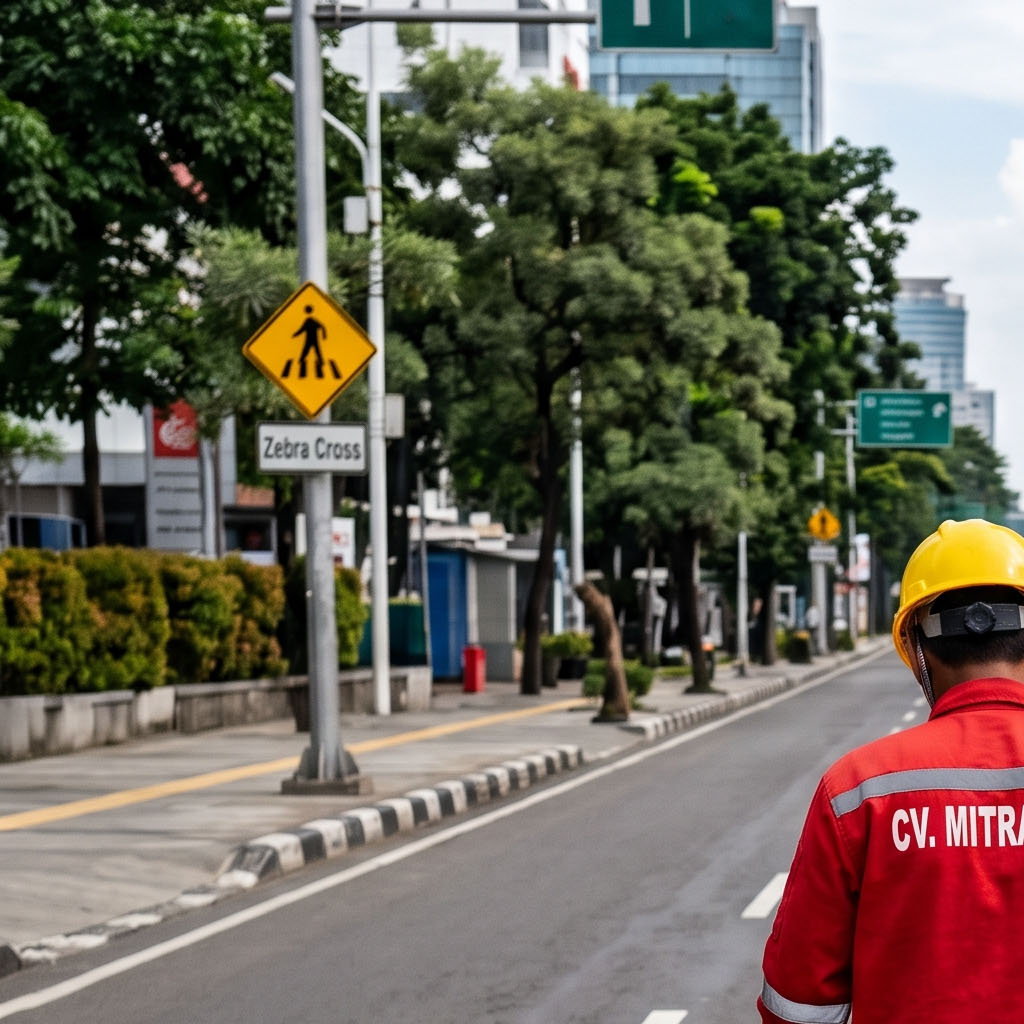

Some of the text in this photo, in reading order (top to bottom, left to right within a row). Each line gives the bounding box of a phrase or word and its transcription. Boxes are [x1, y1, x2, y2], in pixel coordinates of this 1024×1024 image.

[264, 436, 362, 460] Zebra Cross
[891, 806, 936, 852] CV.
